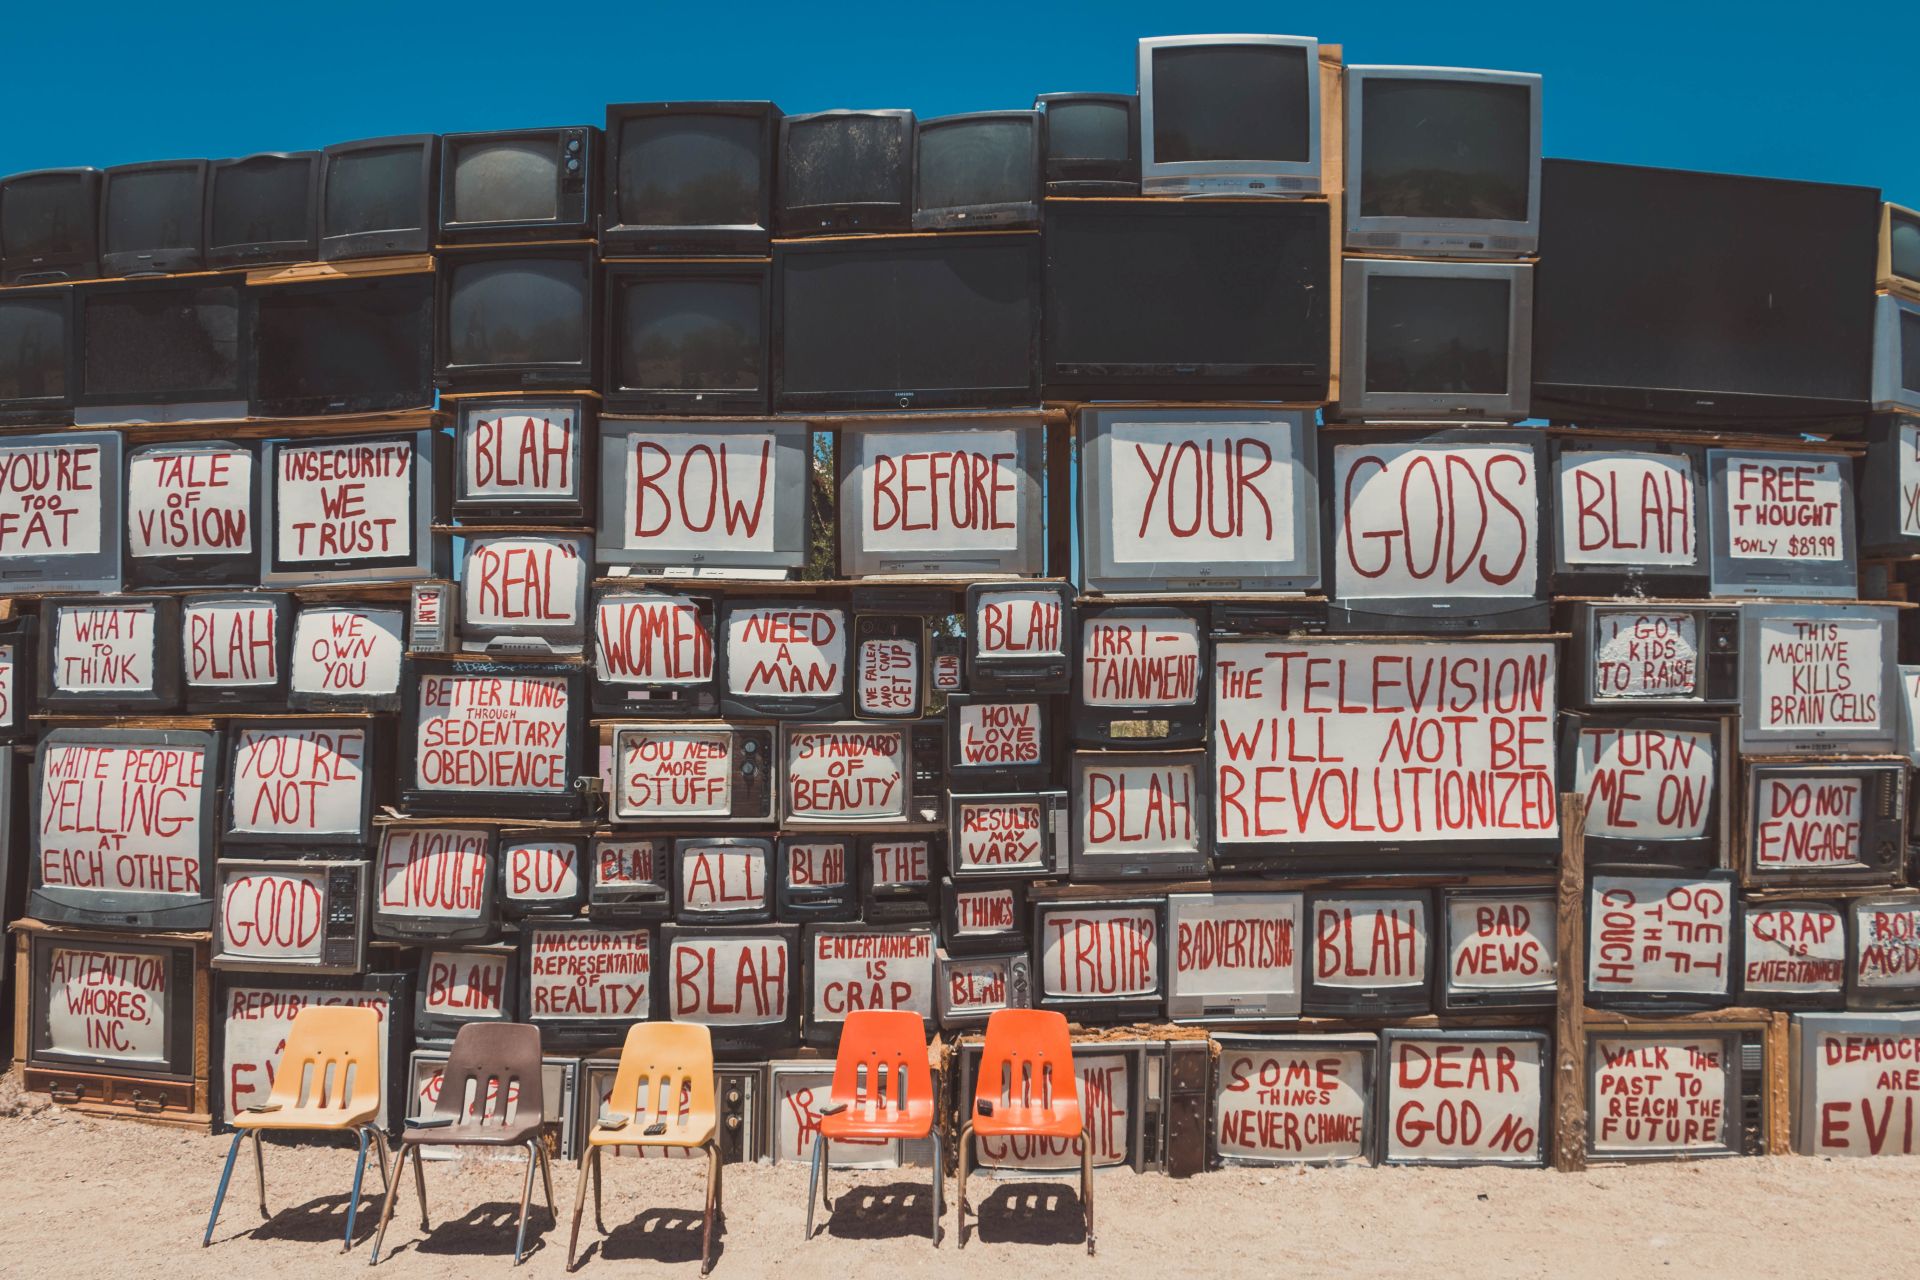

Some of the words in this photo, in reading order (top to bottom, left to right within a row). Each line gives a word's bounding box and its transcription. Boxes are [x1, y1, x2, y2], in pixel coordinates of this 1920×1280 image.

[0, 448, 98, 492] YOU'RE
[284, 447, 410, 483] INSECURITY
[475, 416, 571, 490] BLAH
[152, 454, 232, 488] TALE
[21, 493, 62, 512] TOO
[166, 492, 201, 509] OF
[320, 483, 367, 520] WE
[634, 440, 770, 538] BOW
[872, 450, 1015, 532] BEFORE
[1134, 437, 1273, 541] YOUR
[0, 508, 80, 549] FAT
[137, 505, 246, 548] VISION
[1343, 453, 1528, 586] GODS
[1575, 469, 1688, 554] BLAH
[1733, 502, 1838, 528] THOUGHT
[291, 518, 397, 557] TRUST
[1788, 535, 1836, 558] $89.99
[474, 543, 577, 620] "REAL"
[73, 609, 145, 642] WHAT
[331, 613, 367, 637] WE
[600, 603, 713, 679] WOMEN
[742, 611, 837, 646] NEED
[984, 601, 1060, 651] BLAH
[1634, 616, 1686, 640] GOT
[1793, 622, 1838, 641] THIS
[92, 643, 113, 657] TO
[190, 608, 276, 680] BLAH
[311, 635, 377, 663] OWN
[776, 643, 792, 666] A
[891, 645, 912, 669] UP
[1767, 641, 1848, 664] MACHINE
[63, 652, 140, 685] THINK
[322, 660, 366, 689] YOU
[744, 660, 837, 693] MAN
[865, 643, 877, 682] FALLEN
[939, 656, 958, 686] BLAH
[1086, 653, 1198, 701] TAINMENT
[1599, 661, 1632, 691] TO
[1791, 663, 1852, 695] KILLS
[425, 677, 502, 708] BETTER
[509, 677, 567, 709] LIVING
[881, 685, 892, 708] AND
[892, 675, 912, 708] GET
[1216, 660, 1264, 700] THE
[1264, 650, 1548, 714] TELEVISION
[465, 707, 517, 720] THROUGH
[982, 704, 1030, 728] HOW
[1770, 694, 1824, 725] BRAIN
[1829, 693, 1877, 723] CELLS
[423, 718, 566, 748] SEDENTARY
[629, 737, 674, 764] YOU
[682, 740, 728, 759] NEED
[966, 726, 1036, 746] LOVE
[1219, 714, 1345, 763] WILL
[1378, 715, 1479, 768] NOT
[1488, 714, 1549, 772] BE
[1582, 728, 1697, 771] TURN
[48, 744, 115, 780] WHITE
[121, 748, 205, 789] PEOPLE
[241, 731, 362, 783] YOU'RE
[421, 749, 565, 788] OBEDIENCE
[655, 760, 708, 777] MORE
[827, 759, 865, 778] OF
[964, 741, 1038, 763] WORKS
[250, 780, 330, 829] NOT
[627, 772, 726, 807] STUFF
[1219, 764, 1556, 839] REVOLUTIONIZED
[1584, 768, 1646, 828] ME
[1656, 774, 1707, 829] ON
[1771, 781, 1812, 818] DO
[1815, 784, 1857, 816] NOT
[43, 779, 194, 838] YELLING
[963, 806, 1040, 833] RESULTS
[1088, 772, 1191, 844] BLAH
[98, 833, 128, 850] AT
[967, 841, 1039, 865] VARY
[987, 830, 1025, 842] MAY
[1759, 820, 1858, 863] ENGAGE
[43, 849, 105, 888] EACH
[115, 853, 201, 893] OTHER
[383, 830, 488, 911] ENOUGH
[511, 848, 574, 895] BUY
[687, 852, 764, 904] ALL
[791, 847, 844, 886] BLAH
[874, 847, 926, 883] THE
[225, 876, 322, 948] GOOD
[958, 896, 1014, 928] THINGS
[1476, 905, 1531, 938] BAD
[1751, 910, 1836, 945] CRAP
[535, 931, 649, 954] INACCURATE
[1178, 917, 1295, 973] BADVERTISING
[1318, 907, 1416, 979] BLAH
[1595, 888, 1637, 985] COUCH
[1642, 903, 1664, 964] THE
[1665, 886, 1694, 974] OFF
[1693, 888, 1725, 977] GET
[532, 950, 650, 977] REPRESENTATION
[818, 935, 932, 961] ENTERTAINMENT
[1047, 917, 1156, 996] TRUTH?
[1788, 944, 1809, 956] IS
[50, 949, 166, 994] ATTENTION
[428, 962, 503, 1010] BLAH
[576, 972, 601, 988] OF
[675, 944, 787, 1018] BLAH
[865, 959, 888, 981] IS
[533, 982, 646, 1014] REALITY
[823, 980, 913, 1014] CRAP
[951, 970, 1006, 1006] BLAH
[231, 990, 388, 1023] REPUBS
[85, 1016, 137, 1053] INC.
[1225, 1056, 1344, 1092] SOME
[1398, 1043, 1521, 1094] DEAR
[1600, 1043, 1670, 1071] WALK
[1687, 1043, 1721, 1073] THE
[1599, 1073, 1664, 1097] PAST
[1674, 1071, 1705, 1099] TO
[1876, 1069, 1920, 1091] ARE
[1255, 1088, 1333, 1108] THINGS
[1607, 1096, 1680, 1119] REACH
[1685, 1097, 1723, 1119] THE
[1219, 1108, 1303, 1153] NEVER
[1302, 1111, 1362, 1146] CHANGE
[1394, 1098, 1484, 1148] GOD
[1486, 1112, 1537, 1154] NO
[1600, 1116, 1717, 1145] FUTURE
